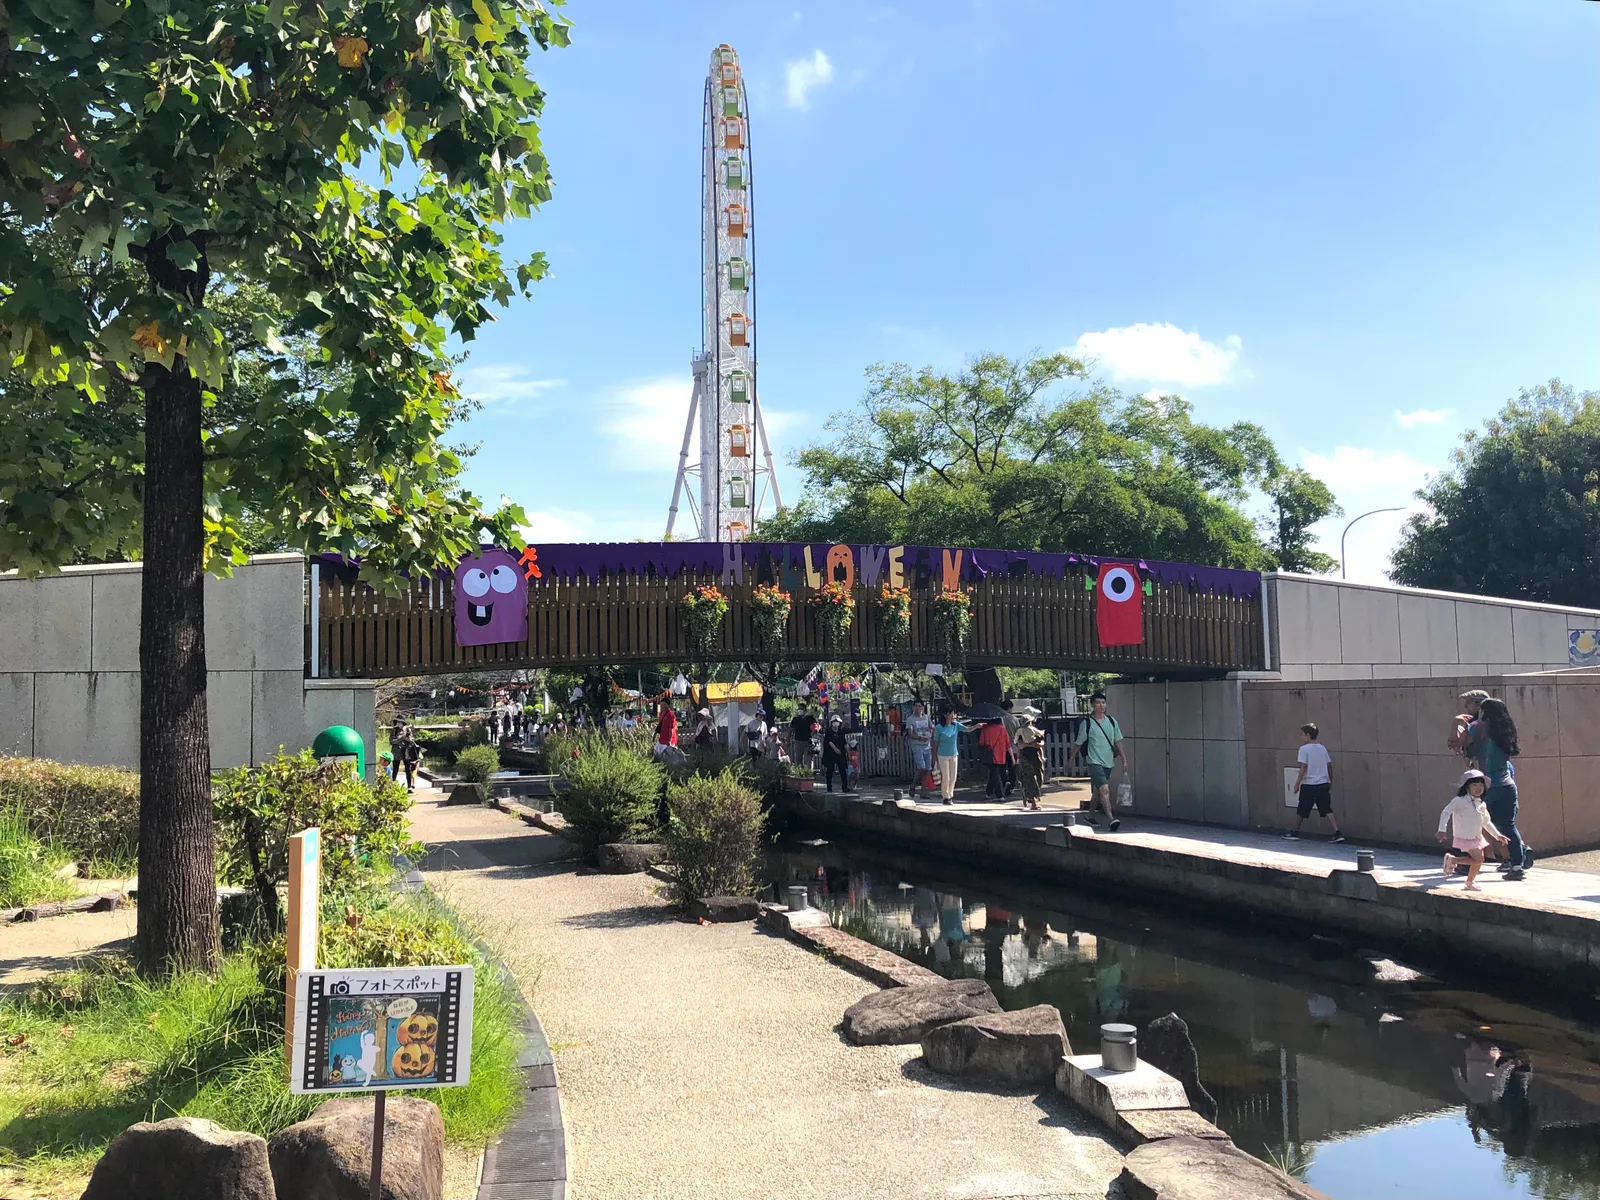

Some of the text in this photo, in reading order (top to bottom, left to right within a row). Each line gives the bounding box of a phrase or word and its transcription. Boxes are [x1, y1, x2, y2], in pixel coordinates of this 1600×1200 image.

[722, 543, 962, 591] HALLOWEEN
[356, 975, 441, 993] フォトスポット
